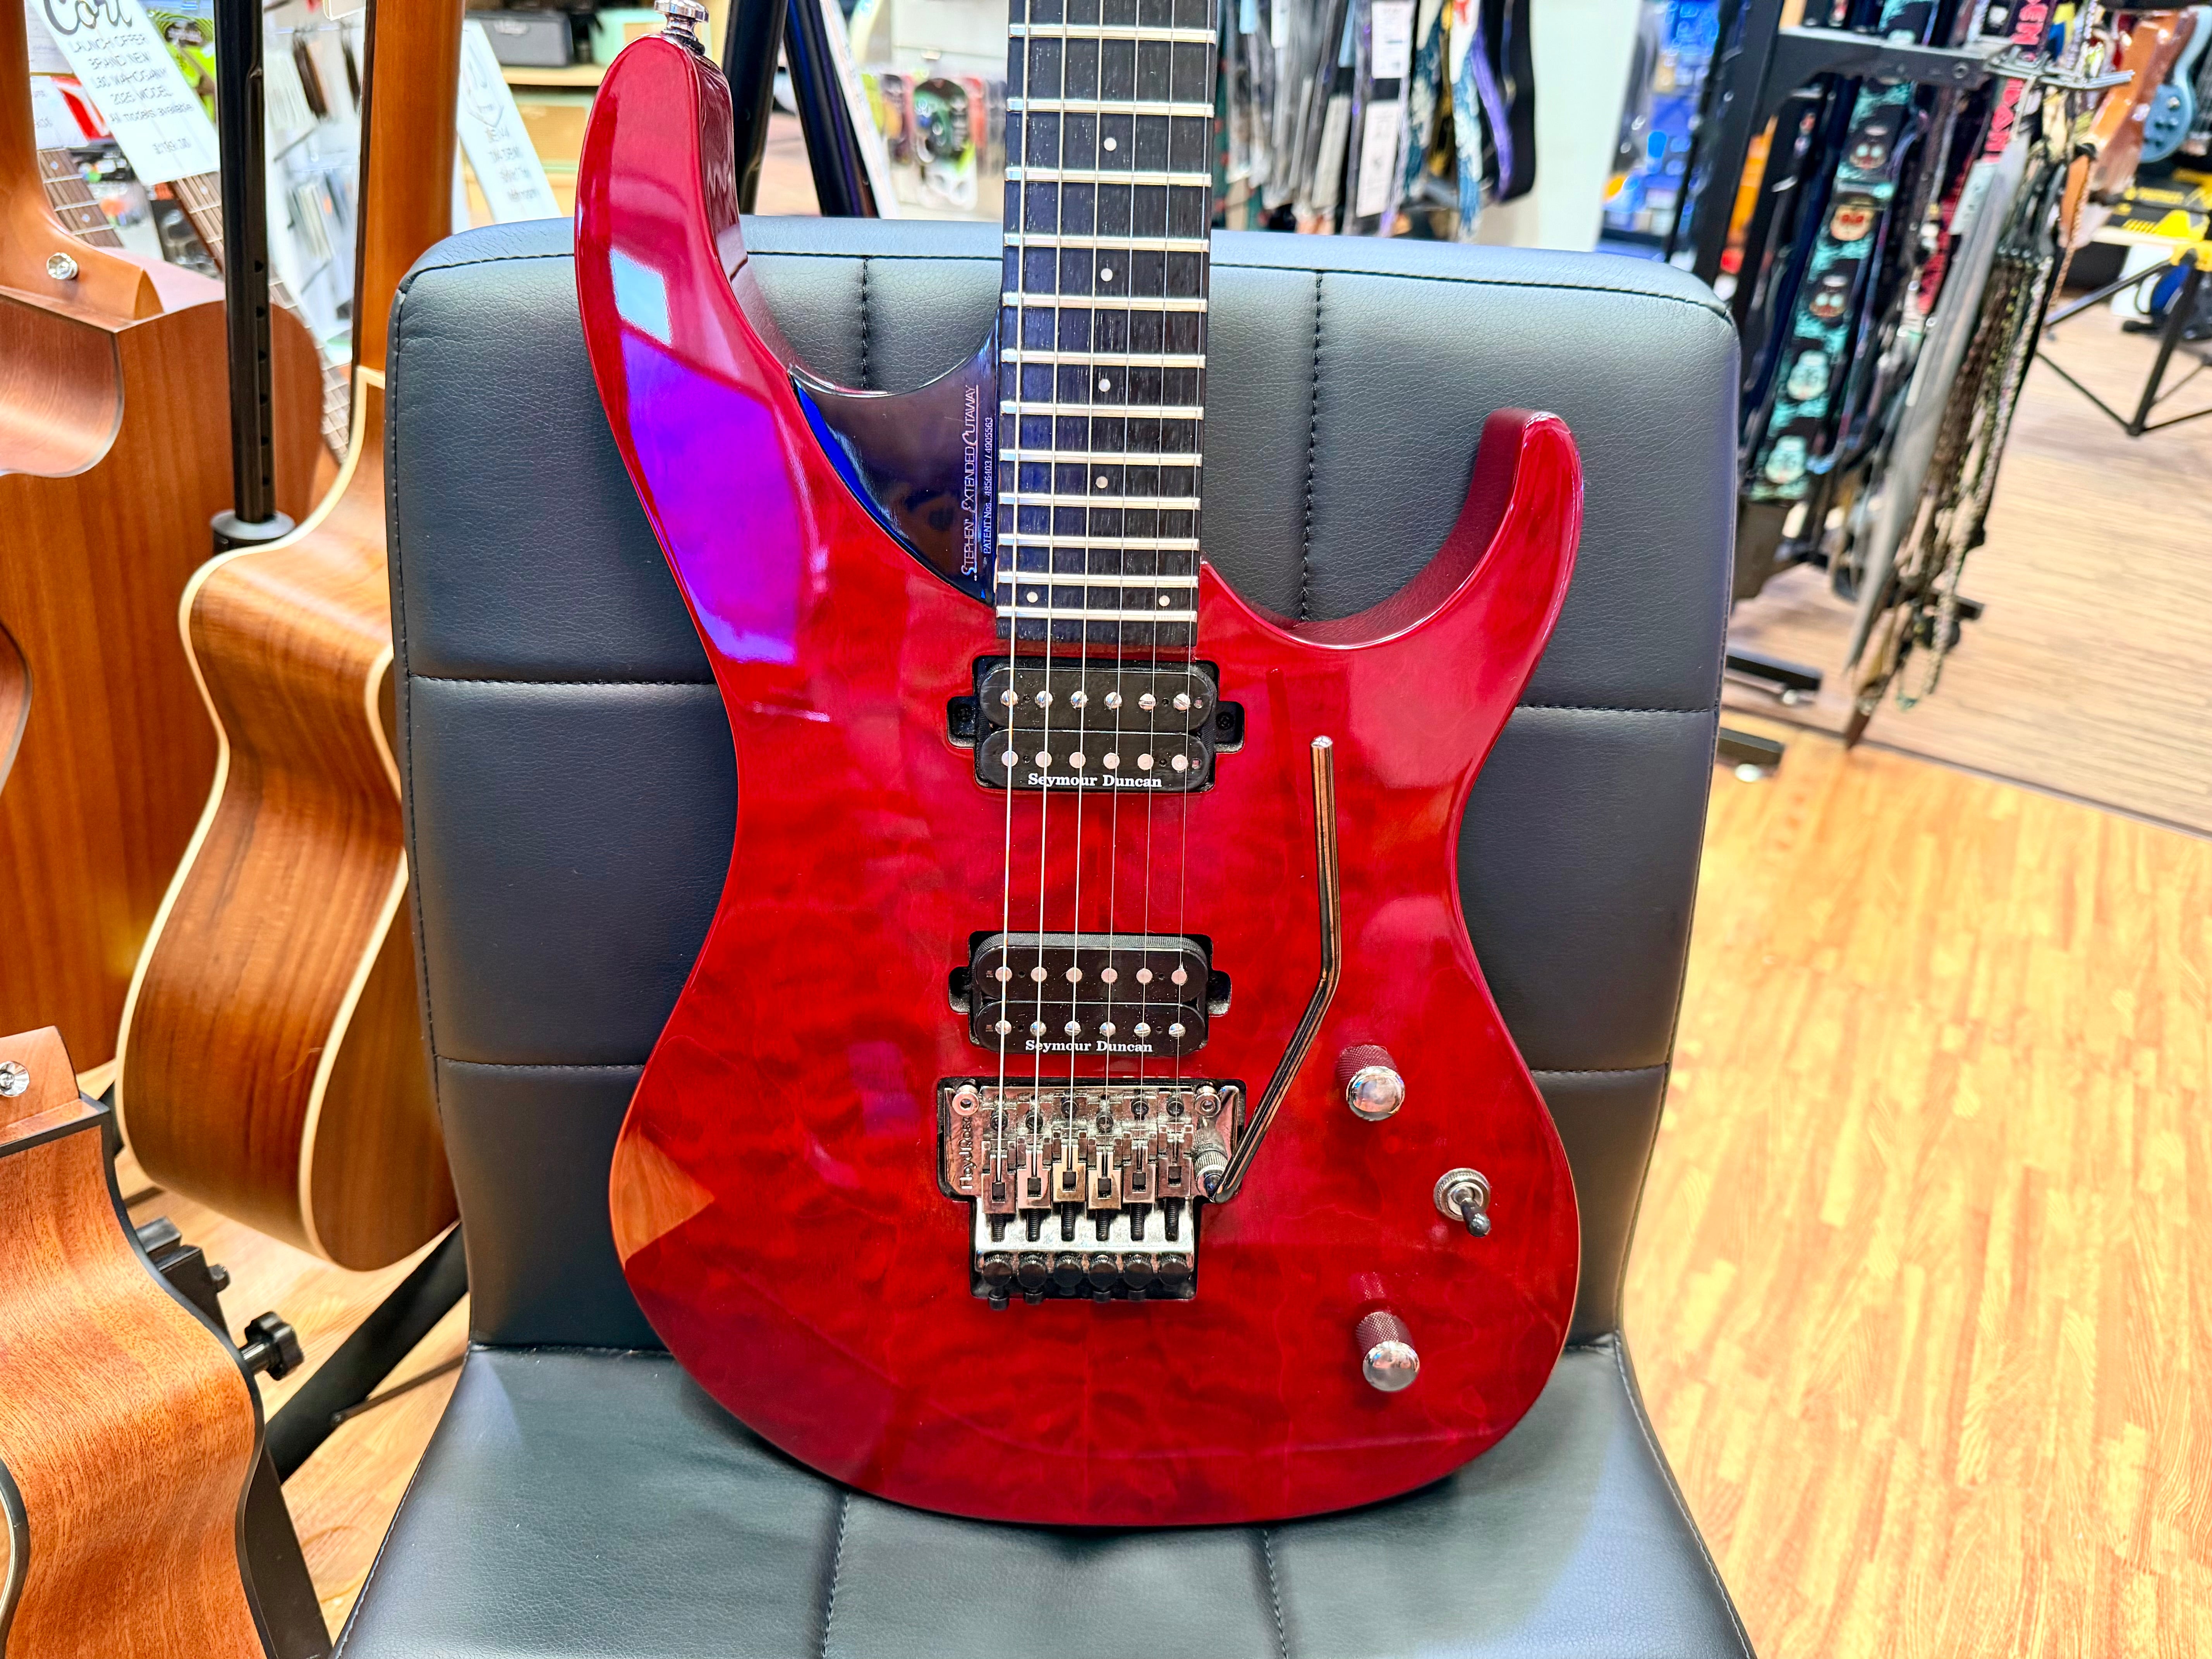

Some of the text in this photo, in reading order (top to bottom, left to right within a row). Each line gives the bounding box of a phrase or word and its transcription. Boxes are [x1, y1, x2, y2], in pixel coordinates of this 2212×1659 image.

[962, 385, 977, 446] CUTAWAY
[985, 417, 993, 453] 4905563
[961, 447, 976, 513] EXTENDED
[984, 461, 992, 496] 4856403
[1028, 773, 1162, 787] Seymour Duncan
[1025, 1040, 1152, 1053] Seymour Duncan
